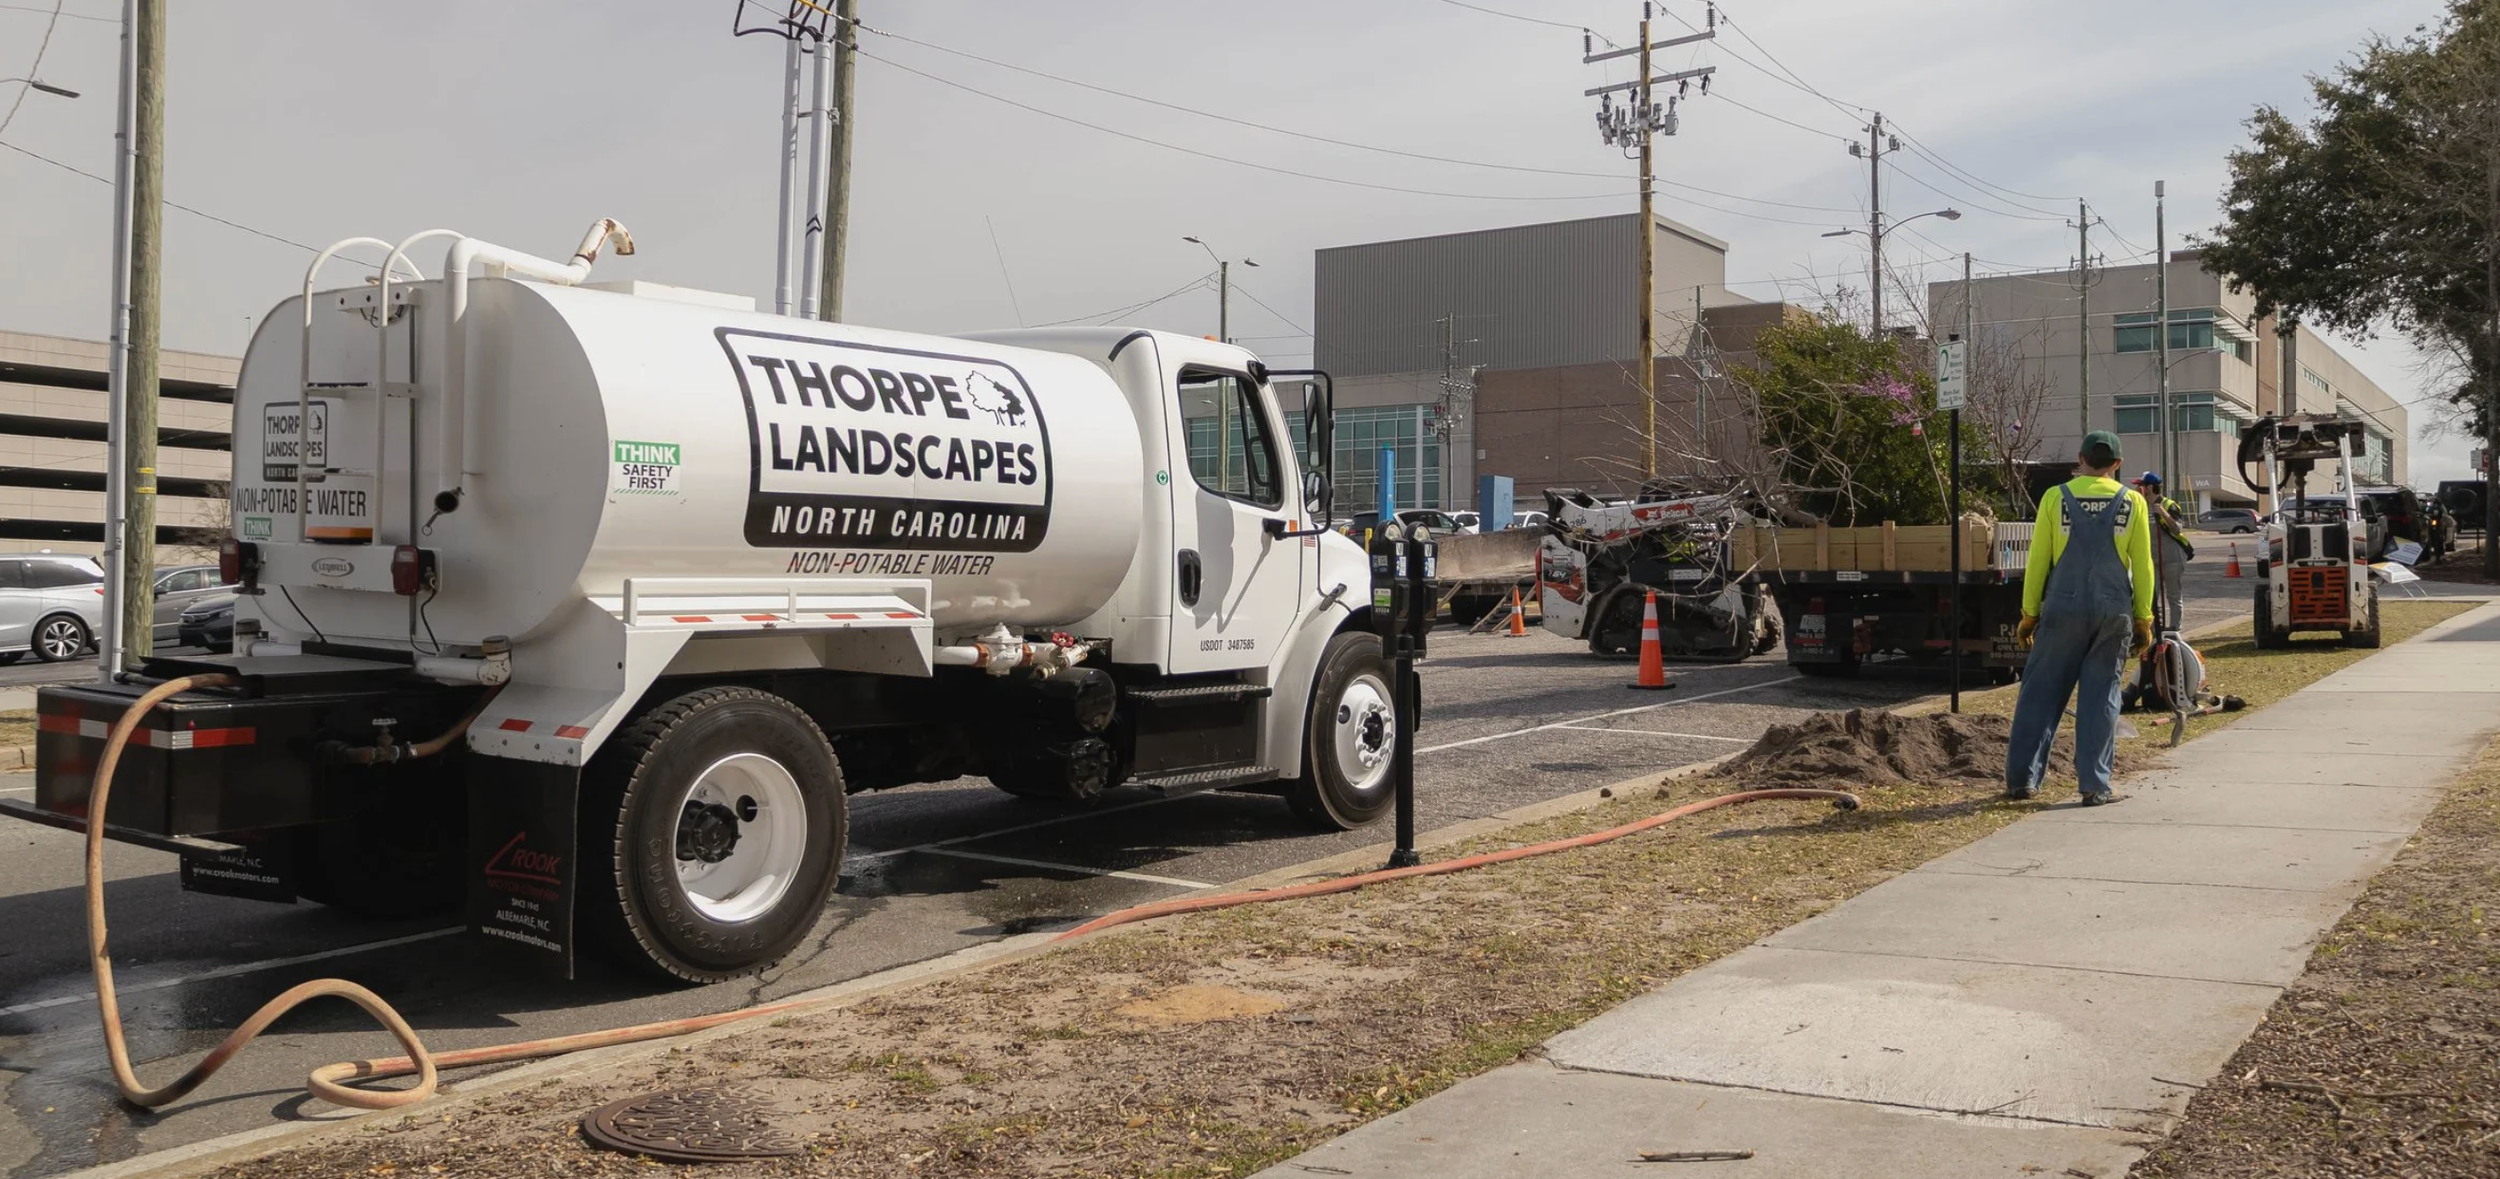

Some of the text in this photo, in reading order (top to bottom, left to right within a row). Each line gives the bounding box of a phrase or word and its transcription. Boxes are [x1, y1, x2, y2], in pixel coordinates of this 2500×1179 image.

[1940, 349, 1949, 382] 2
[747, 354, 971, 420] THORPE
[267, 416, 300, 435] THORP
[266, 441, 322, 458] LANDSCPES
[617, 443, 678, 465] THINK
[769, 422, 1037, 485] LANDSCAPES
[622, 462, 673, 478] SAFETY
[629, 476, 666, 491] FIRST
[236, 488, 367, 517] NON-POTABE WATER
[2063, 501, 2110, 512] TORP
[245, 519, 271, 536] THINK
[772, 506, 1025, 541] NORTH CAROLINA
[787, 551, 995, 576] NON-POTABLE WATER
[1200, 638, 1255, 652] USDOT 3487585
[193, 868, 279, 883] www.crookmotors.com
[511, 897, 526, 909] SINCE
[482, 925, 561, 952] www.crookmotors.com
